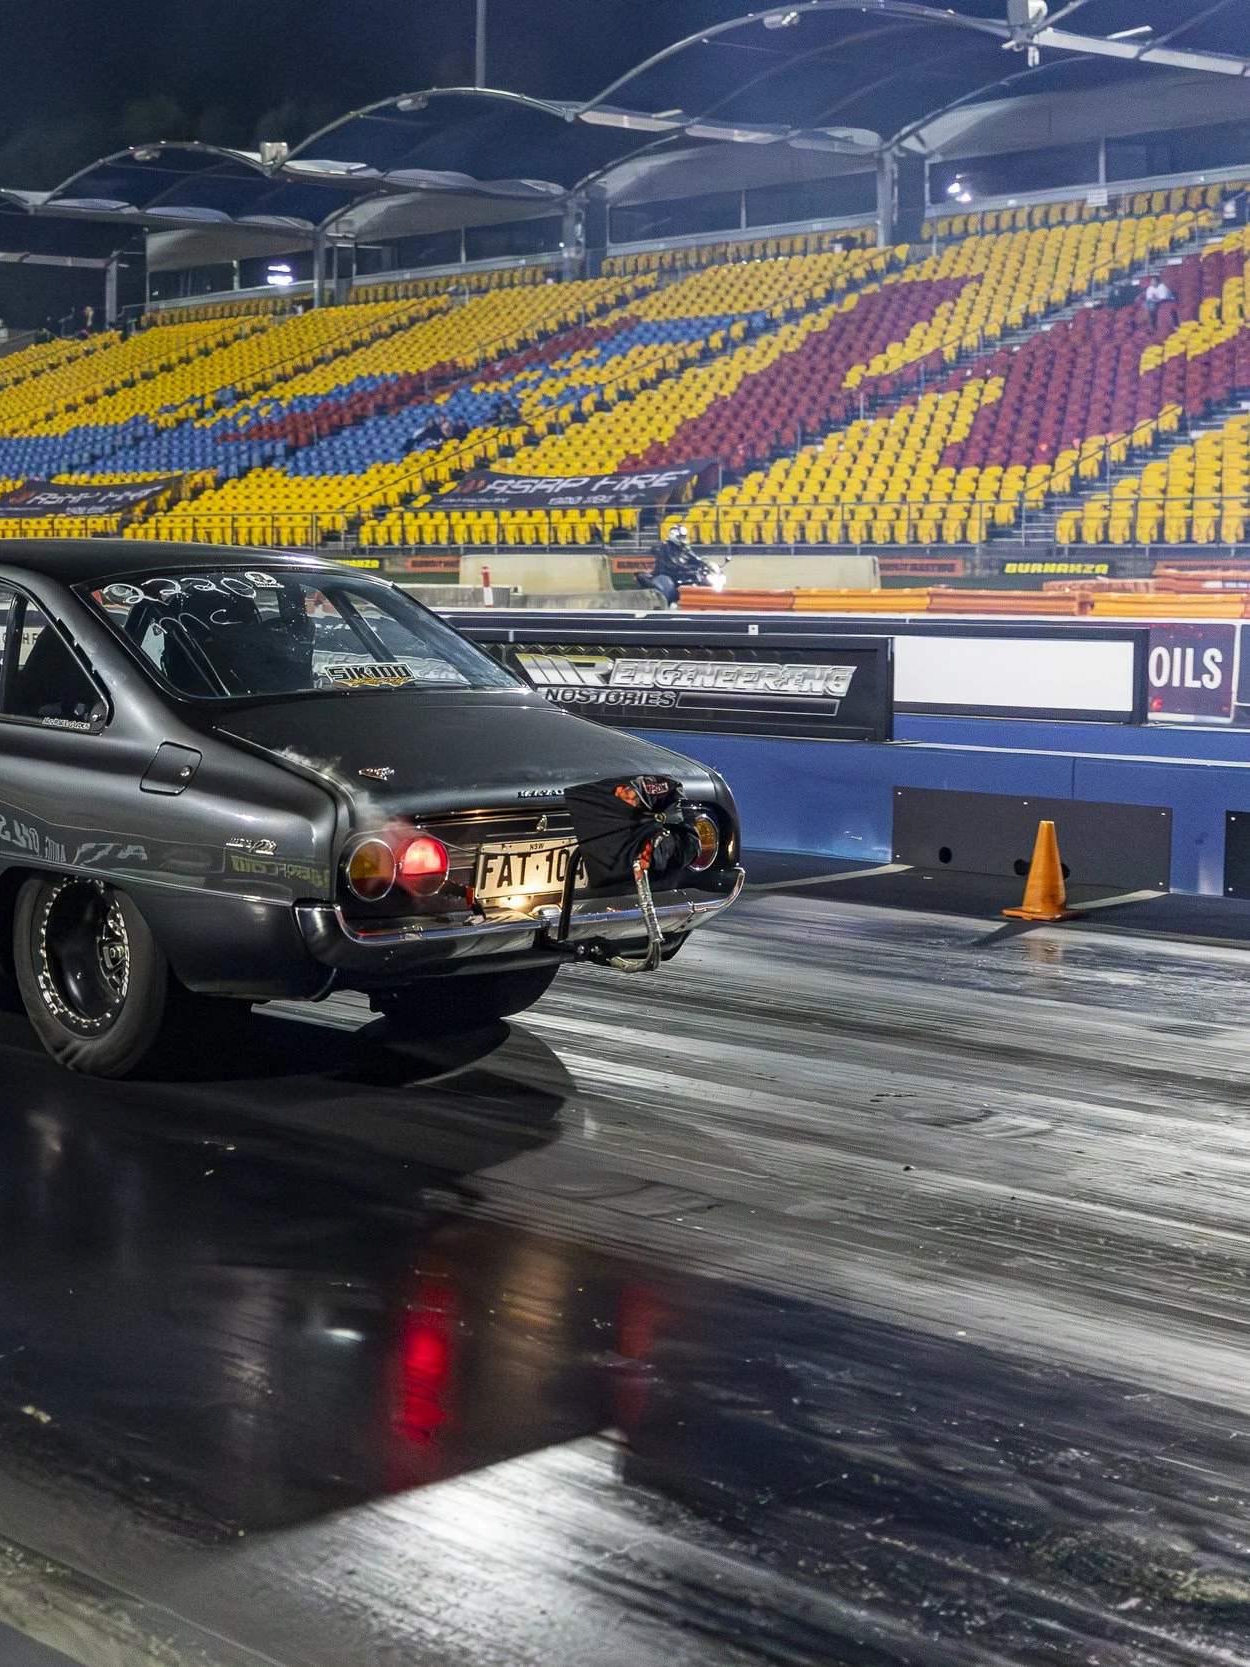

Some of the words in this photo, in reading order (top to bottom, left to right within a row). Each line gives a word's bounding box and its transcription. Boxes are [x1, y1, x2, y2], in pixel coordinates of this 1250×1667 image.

[610, 659, 857, 697] ENGINEERING
[1148, 646, 1223, 690] OILS
[480, 850, 532, 890] FAT
